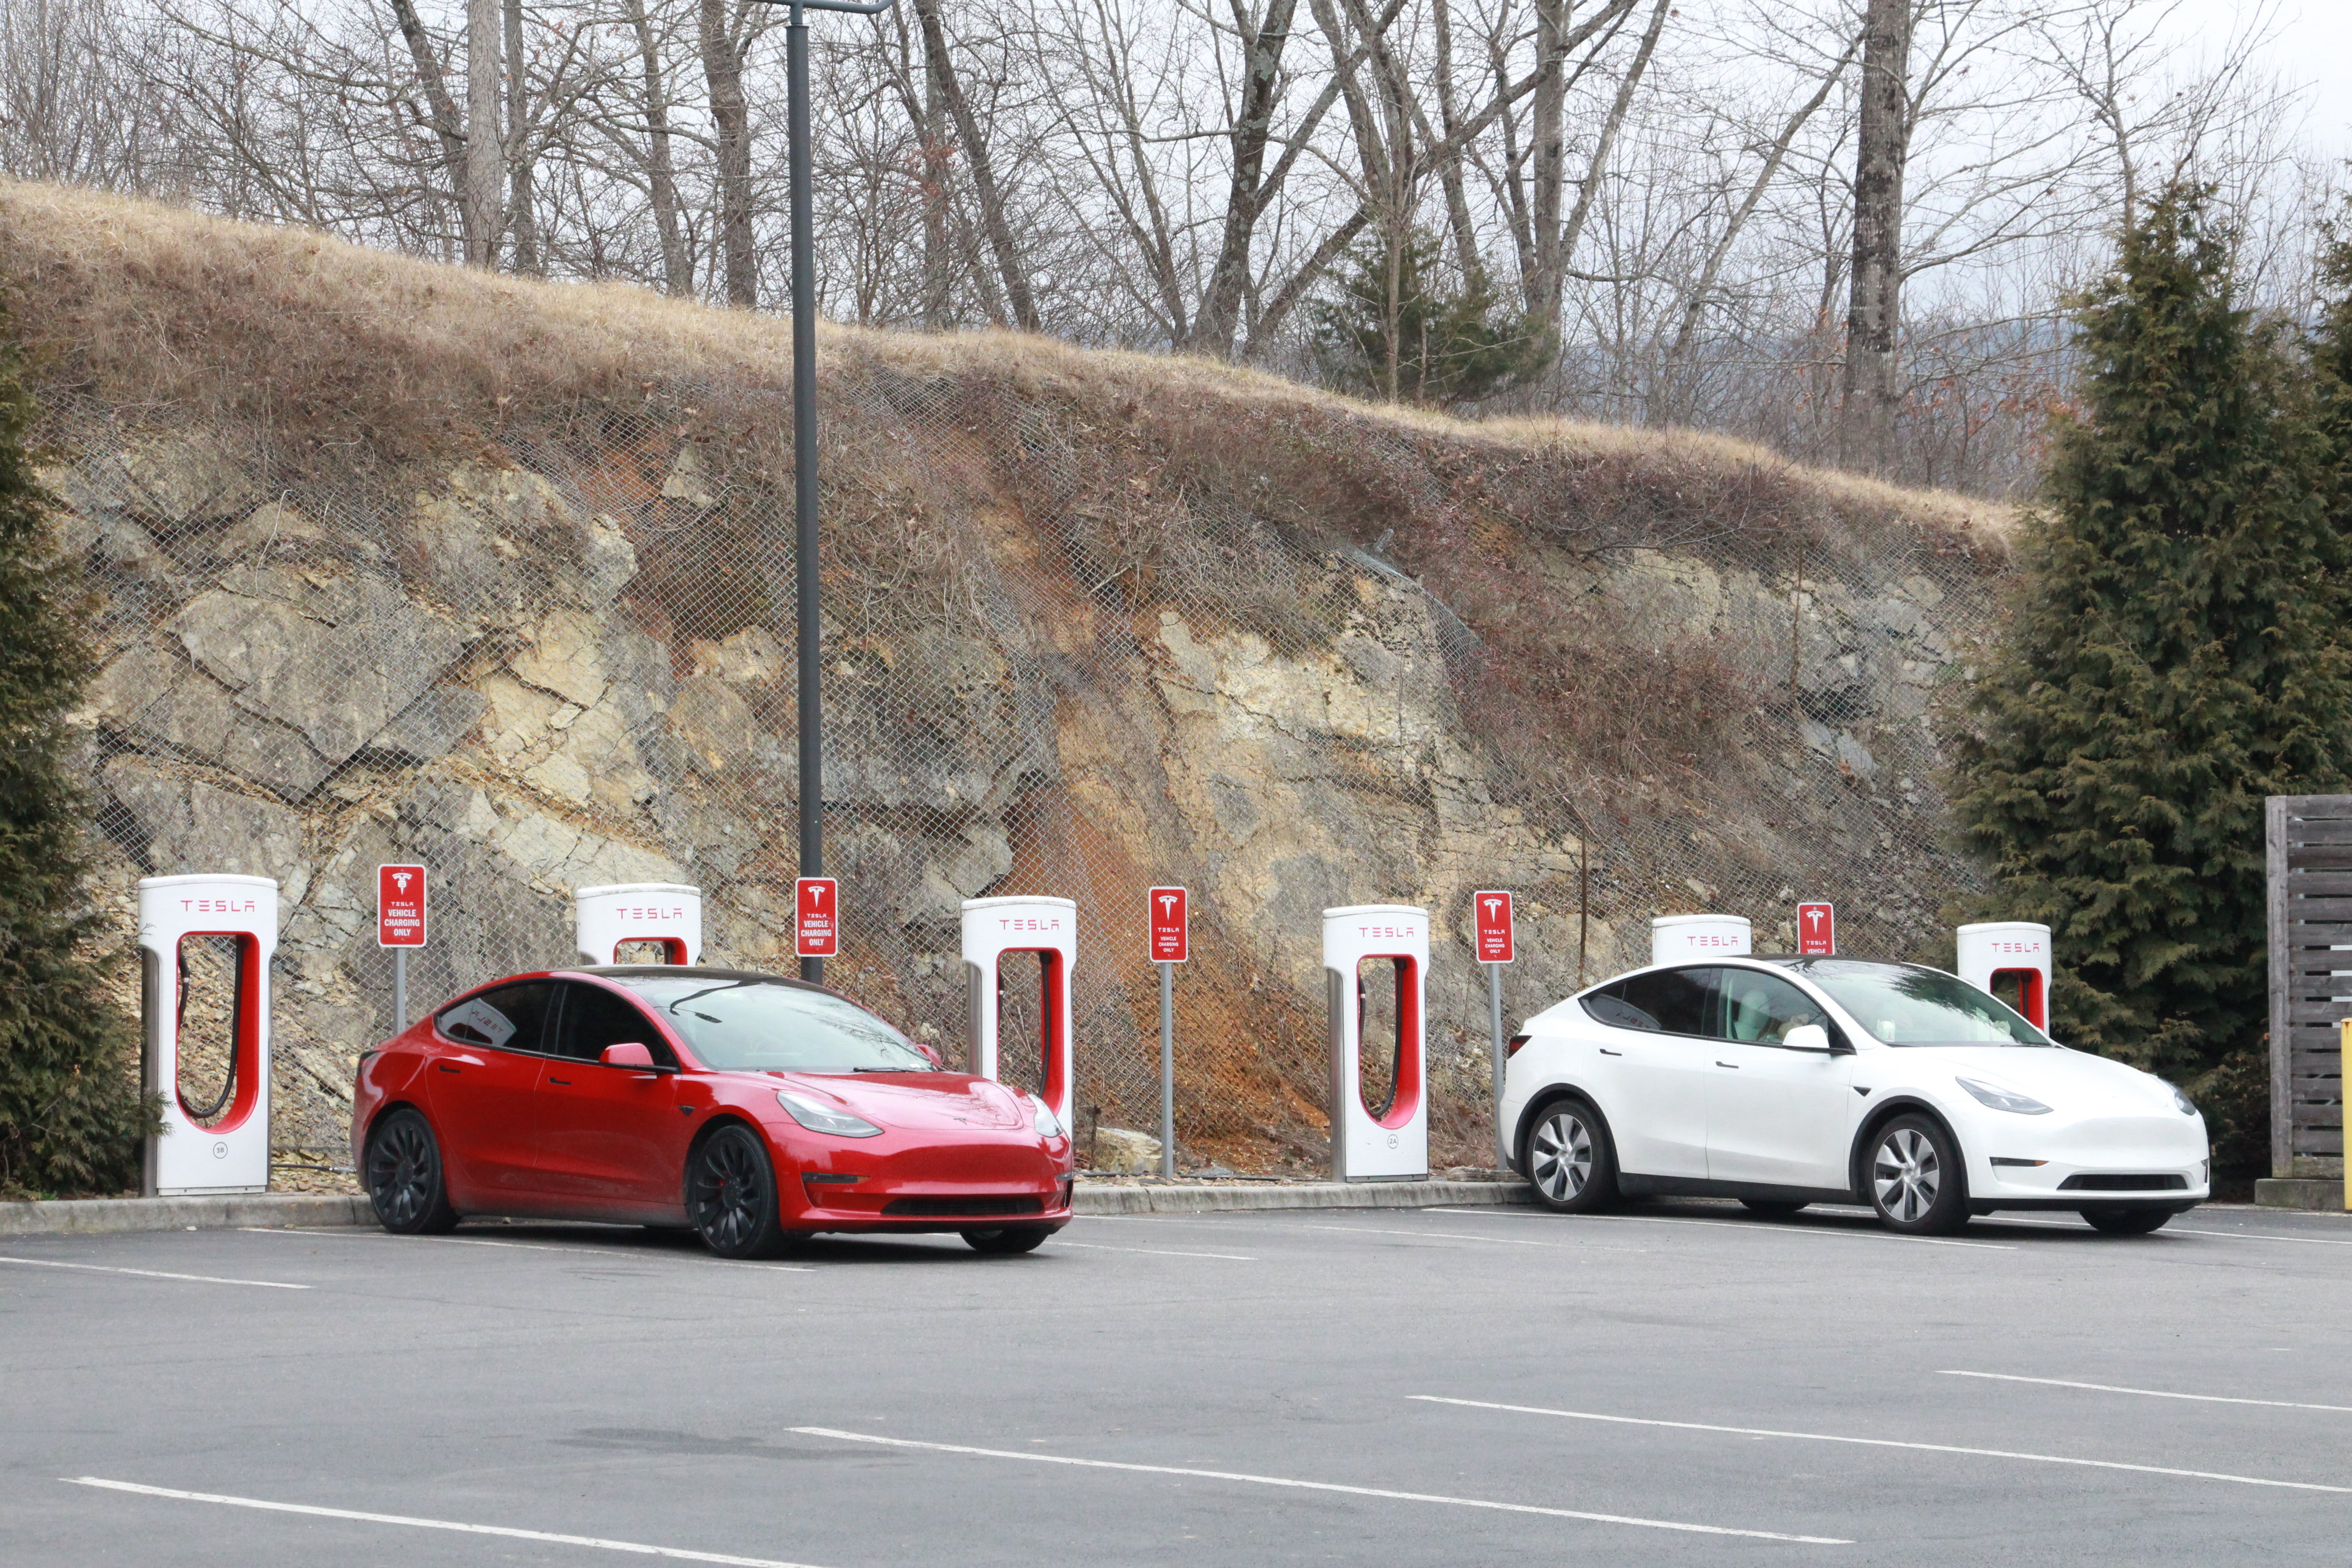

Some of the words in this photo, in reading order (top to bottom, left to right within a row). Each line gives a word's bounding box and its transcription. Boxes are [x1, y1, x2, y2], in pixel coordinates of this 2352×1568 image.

[181, 900, 255, 912] TESLA
[388, 909, 416, 917] VEHICLE
[616, 908, 682, 919] TESLA
[384, 918, 420, 926] CHARGING
[804, 920, 829, 928] VEHICLE
[1000, 919, 1059, 930] TESLA
[393, 928, 412, 936] ONLY
[800, 929, 832, 937] CHARGING
[1359, 927, 1414, 937] TESLA
[1687, 936, 1738, 946] TESLA
[1992, 943, 2040, 952] TESLA
